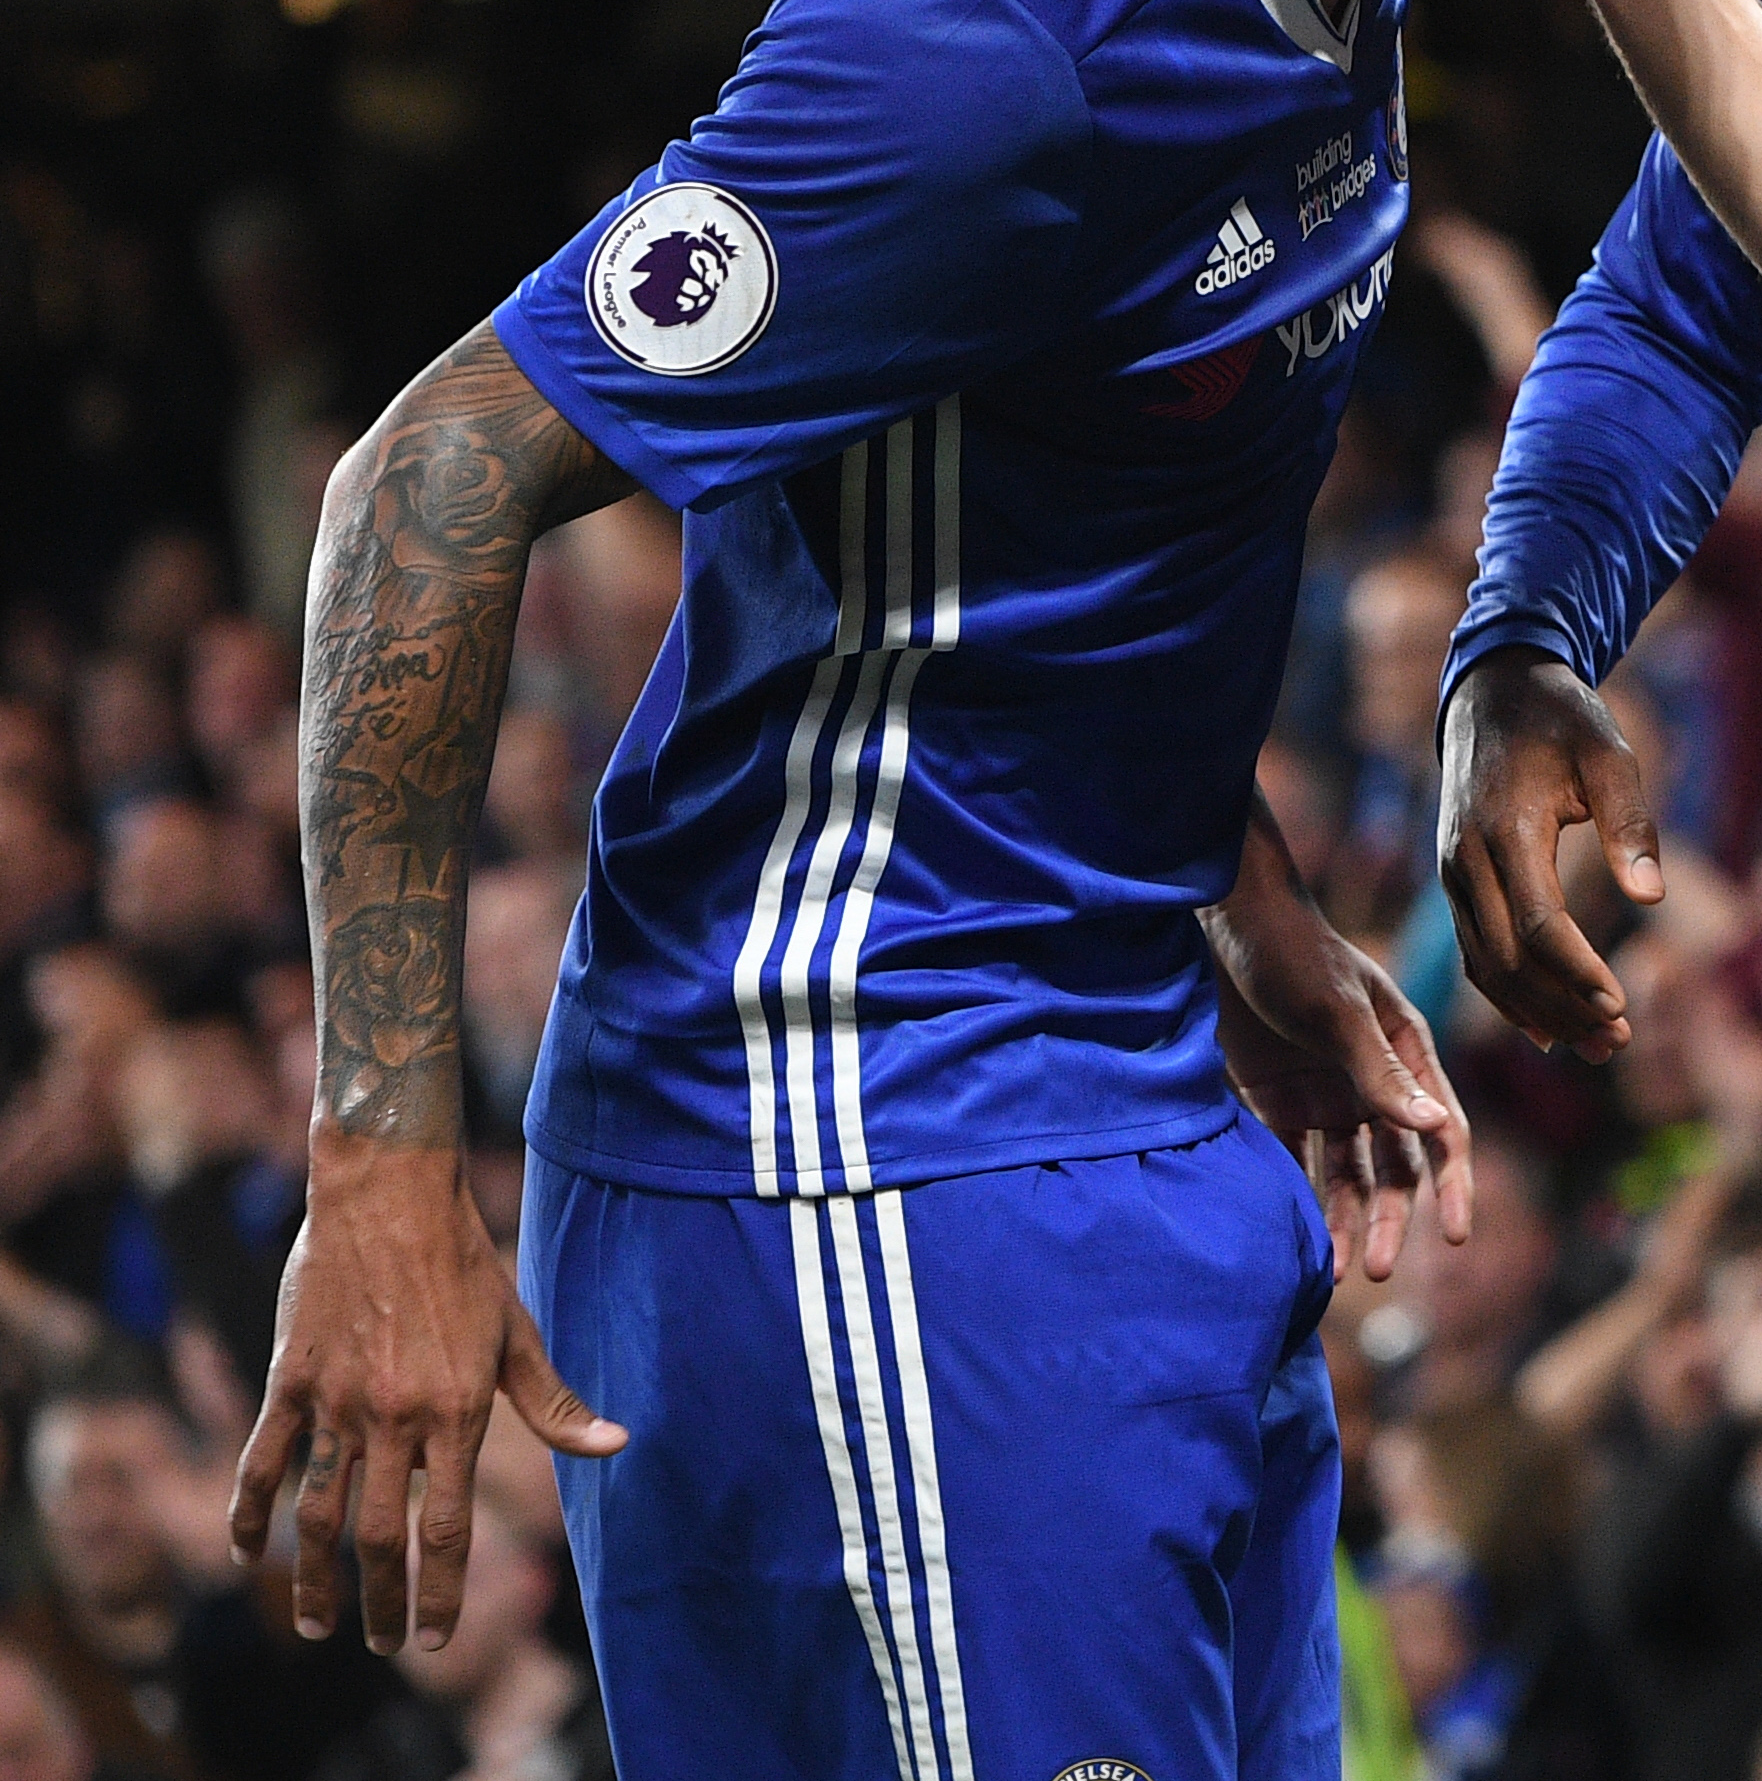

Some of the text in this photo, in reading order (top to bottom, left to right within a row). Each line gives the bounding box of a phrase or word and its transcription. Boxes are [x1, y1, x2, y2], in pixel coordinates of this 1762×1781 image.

[1295, 131, 1352, 193] building
[1330, 153, 1376, 211] bridges
[602, 216, 647, 329] Premier League
[1194, 238, 1276, 296] adidas
